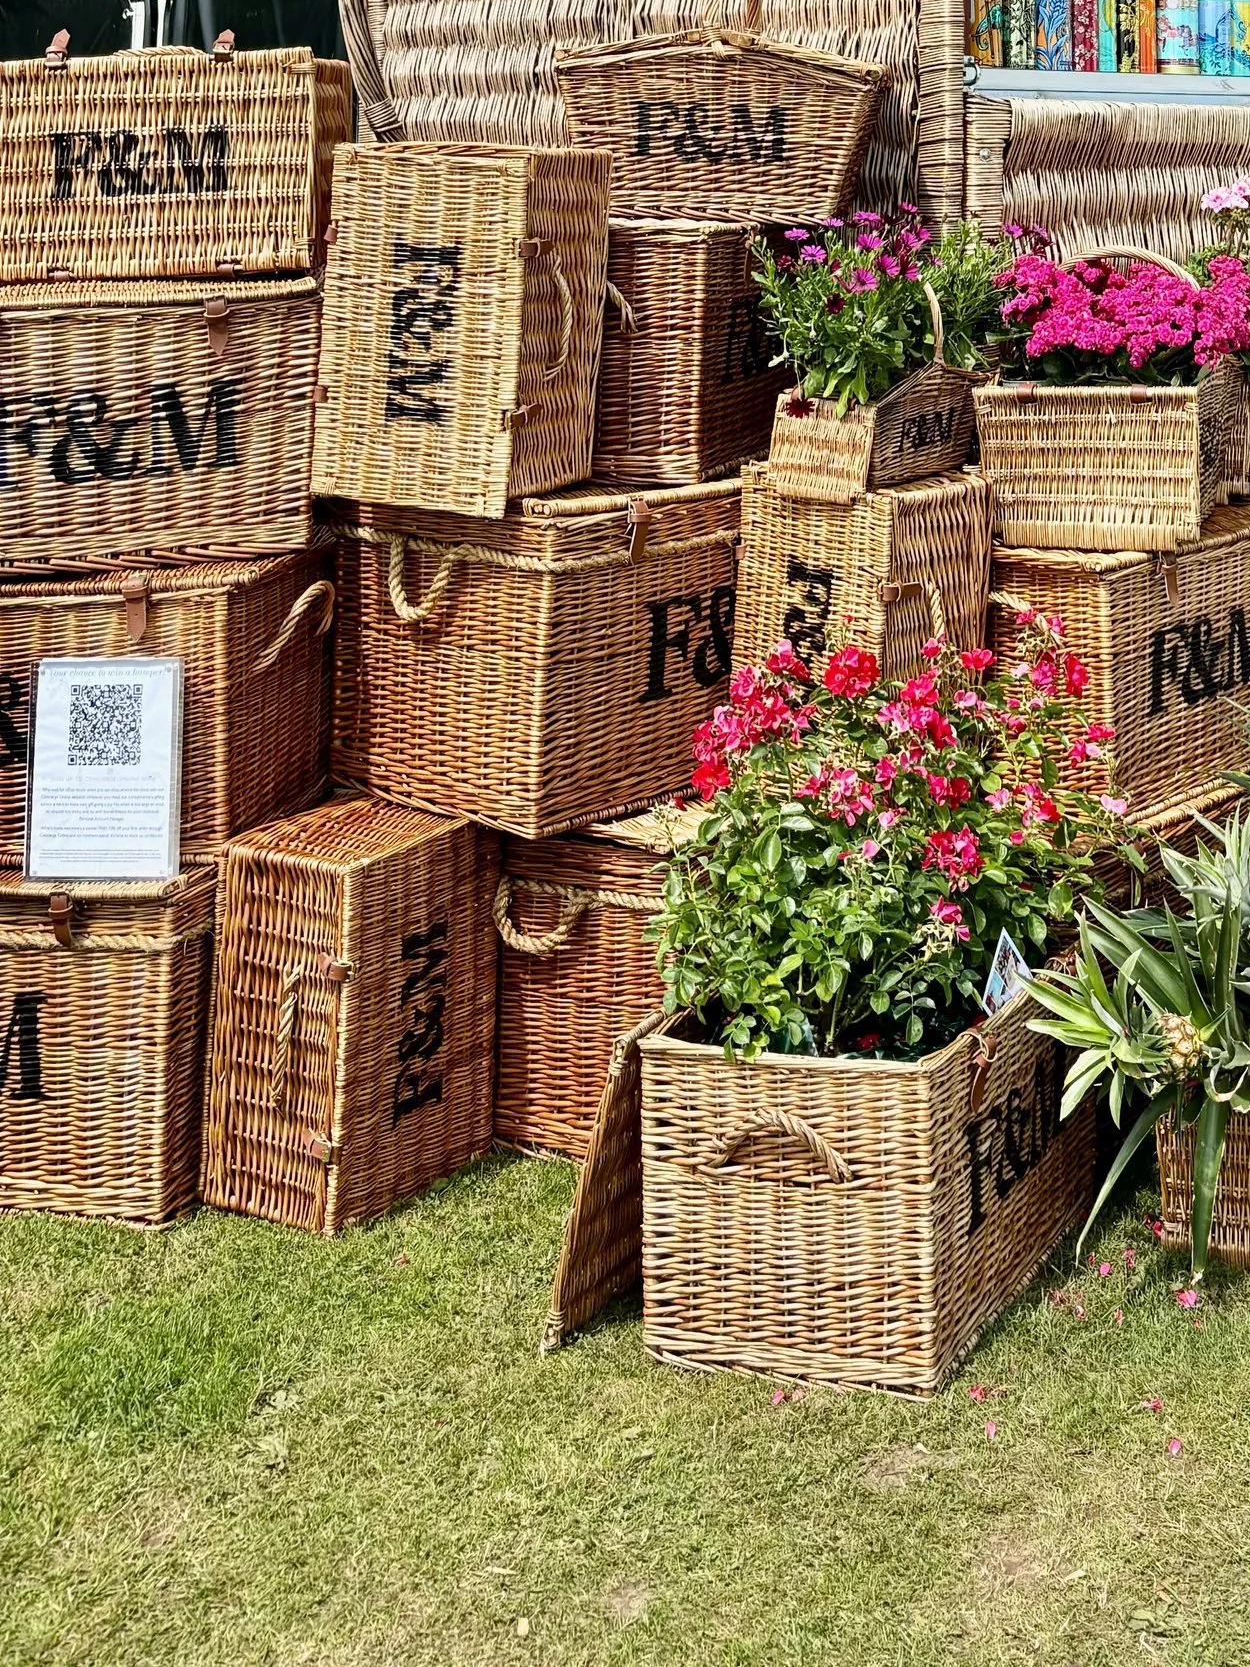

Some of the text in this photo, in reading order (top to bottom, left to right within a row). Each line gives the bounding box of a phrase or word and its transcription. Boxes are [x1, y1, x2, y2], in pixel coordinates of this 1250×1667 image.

[51, 125, 232, 201] F&M
[632, 101, 788, 163] F&M
[385, 238, 462, 425] F&M
[899, 406, 954, 452] F&M
[49, 669, 67, 677] Your
[69, 669, 96, 677] chance
[98, 669, 106, 677] to
[107, 669, 124, 677] win
[640, 587, 736, 702] F&
[392, 919, 448, 1130] F&M
[963, 1045, 1067, 1235] F&M
